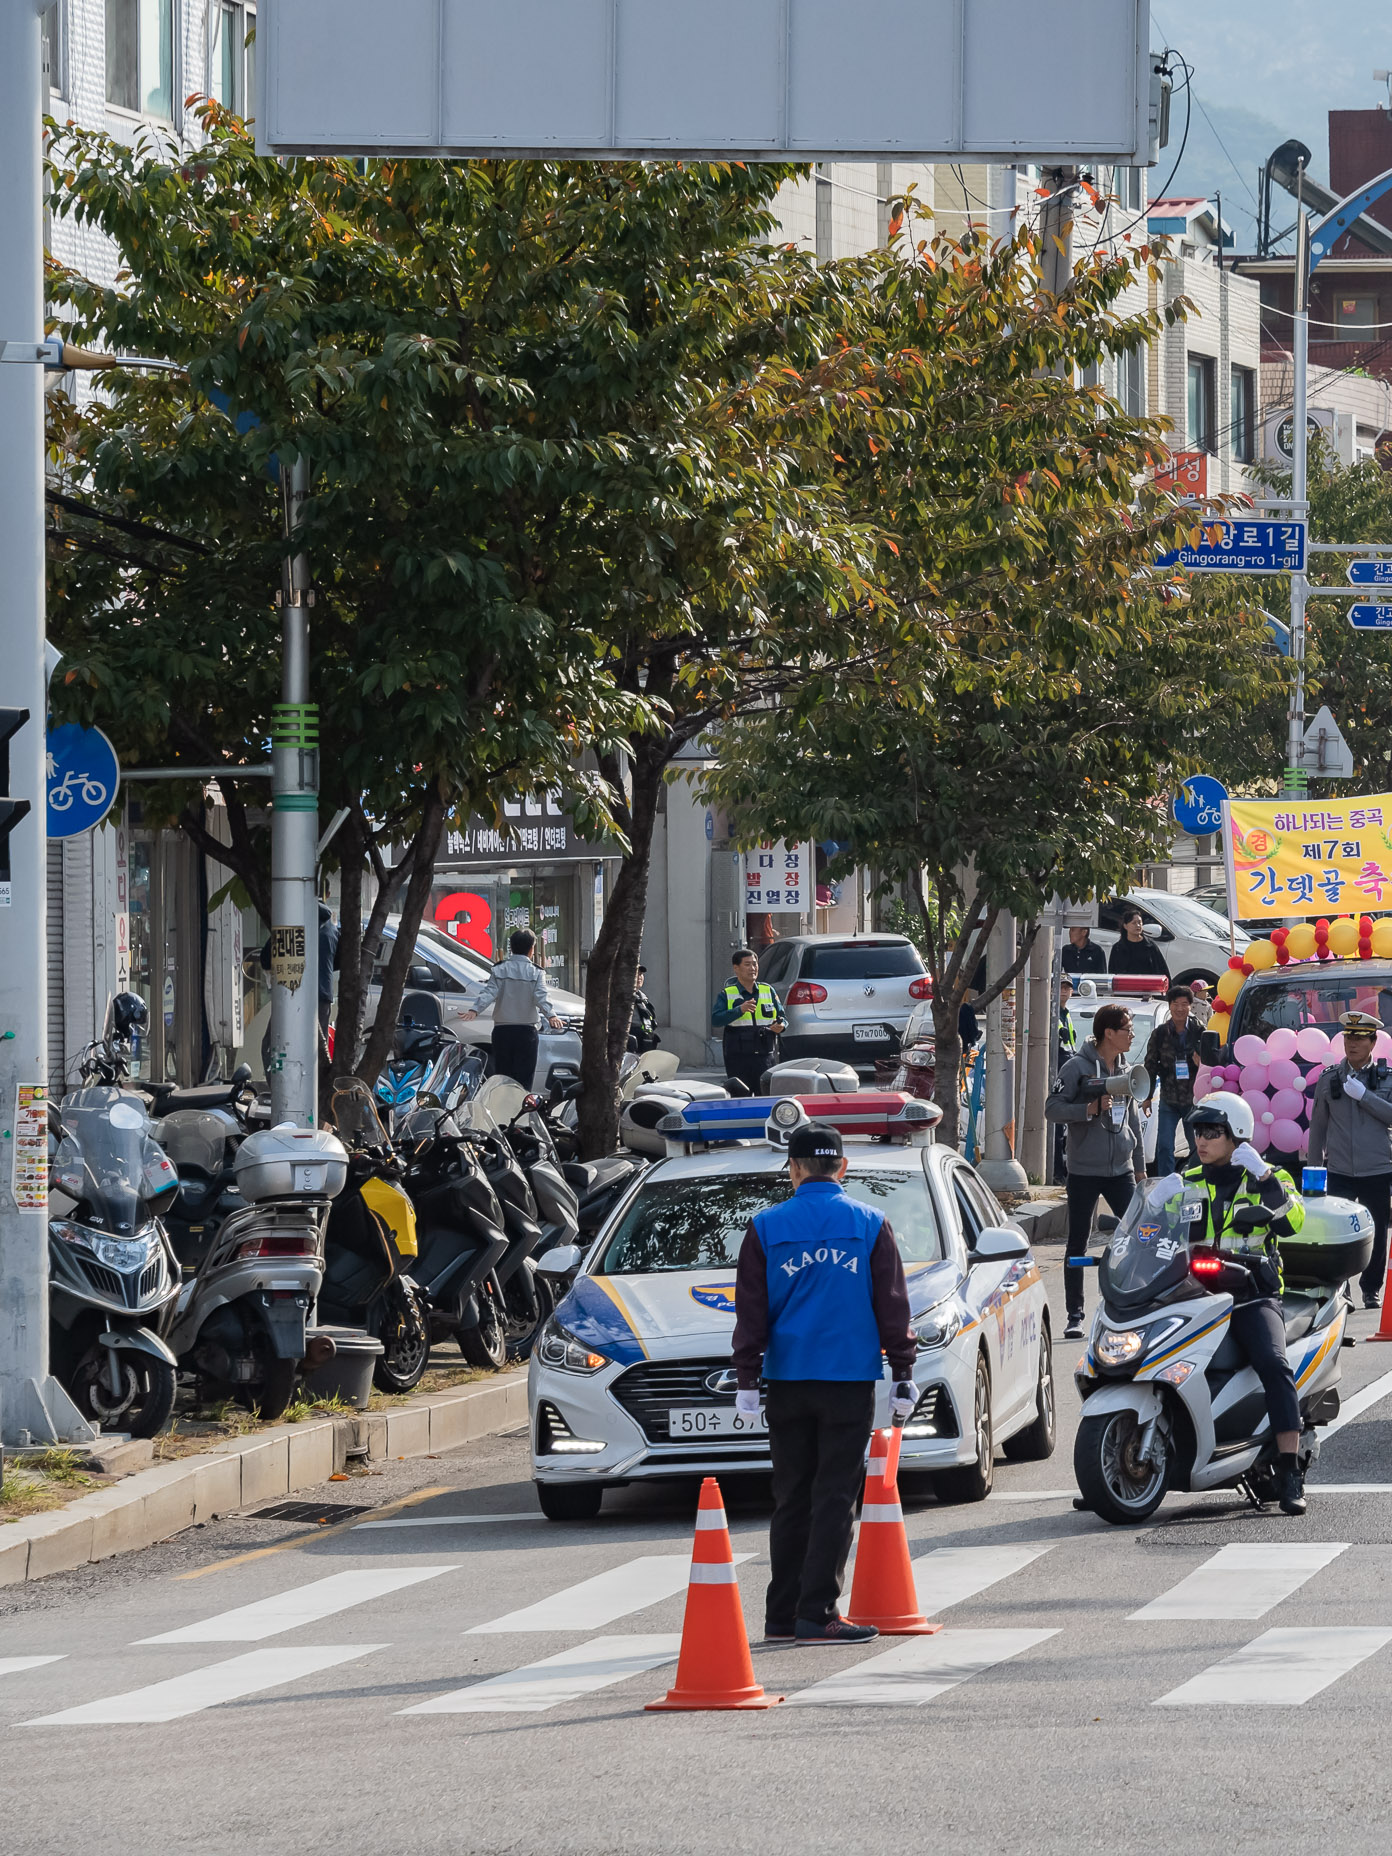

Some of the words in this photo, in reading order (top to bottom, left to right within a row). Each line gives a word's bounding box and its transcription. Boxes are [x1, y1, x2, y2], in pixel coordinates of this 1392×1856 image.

[1178, 551, 1265, 567] Gingorang-ro
[1271, 553, 1300, 568] 1-gil
[1274, 811, 1344, 832] 하나되는
[1349, 808, 1383, 829] 중곡
[1251, 833, 1268, 851] 경
[1302, 840, 1362, 860] 제7회
[1248, 866, 1347, 905] 간뎃골
[434, 892, 493, 960] 3
[814, 1148, 838, 1156] KAOVA
[780, 1247, 859, 1278] KAOVA
